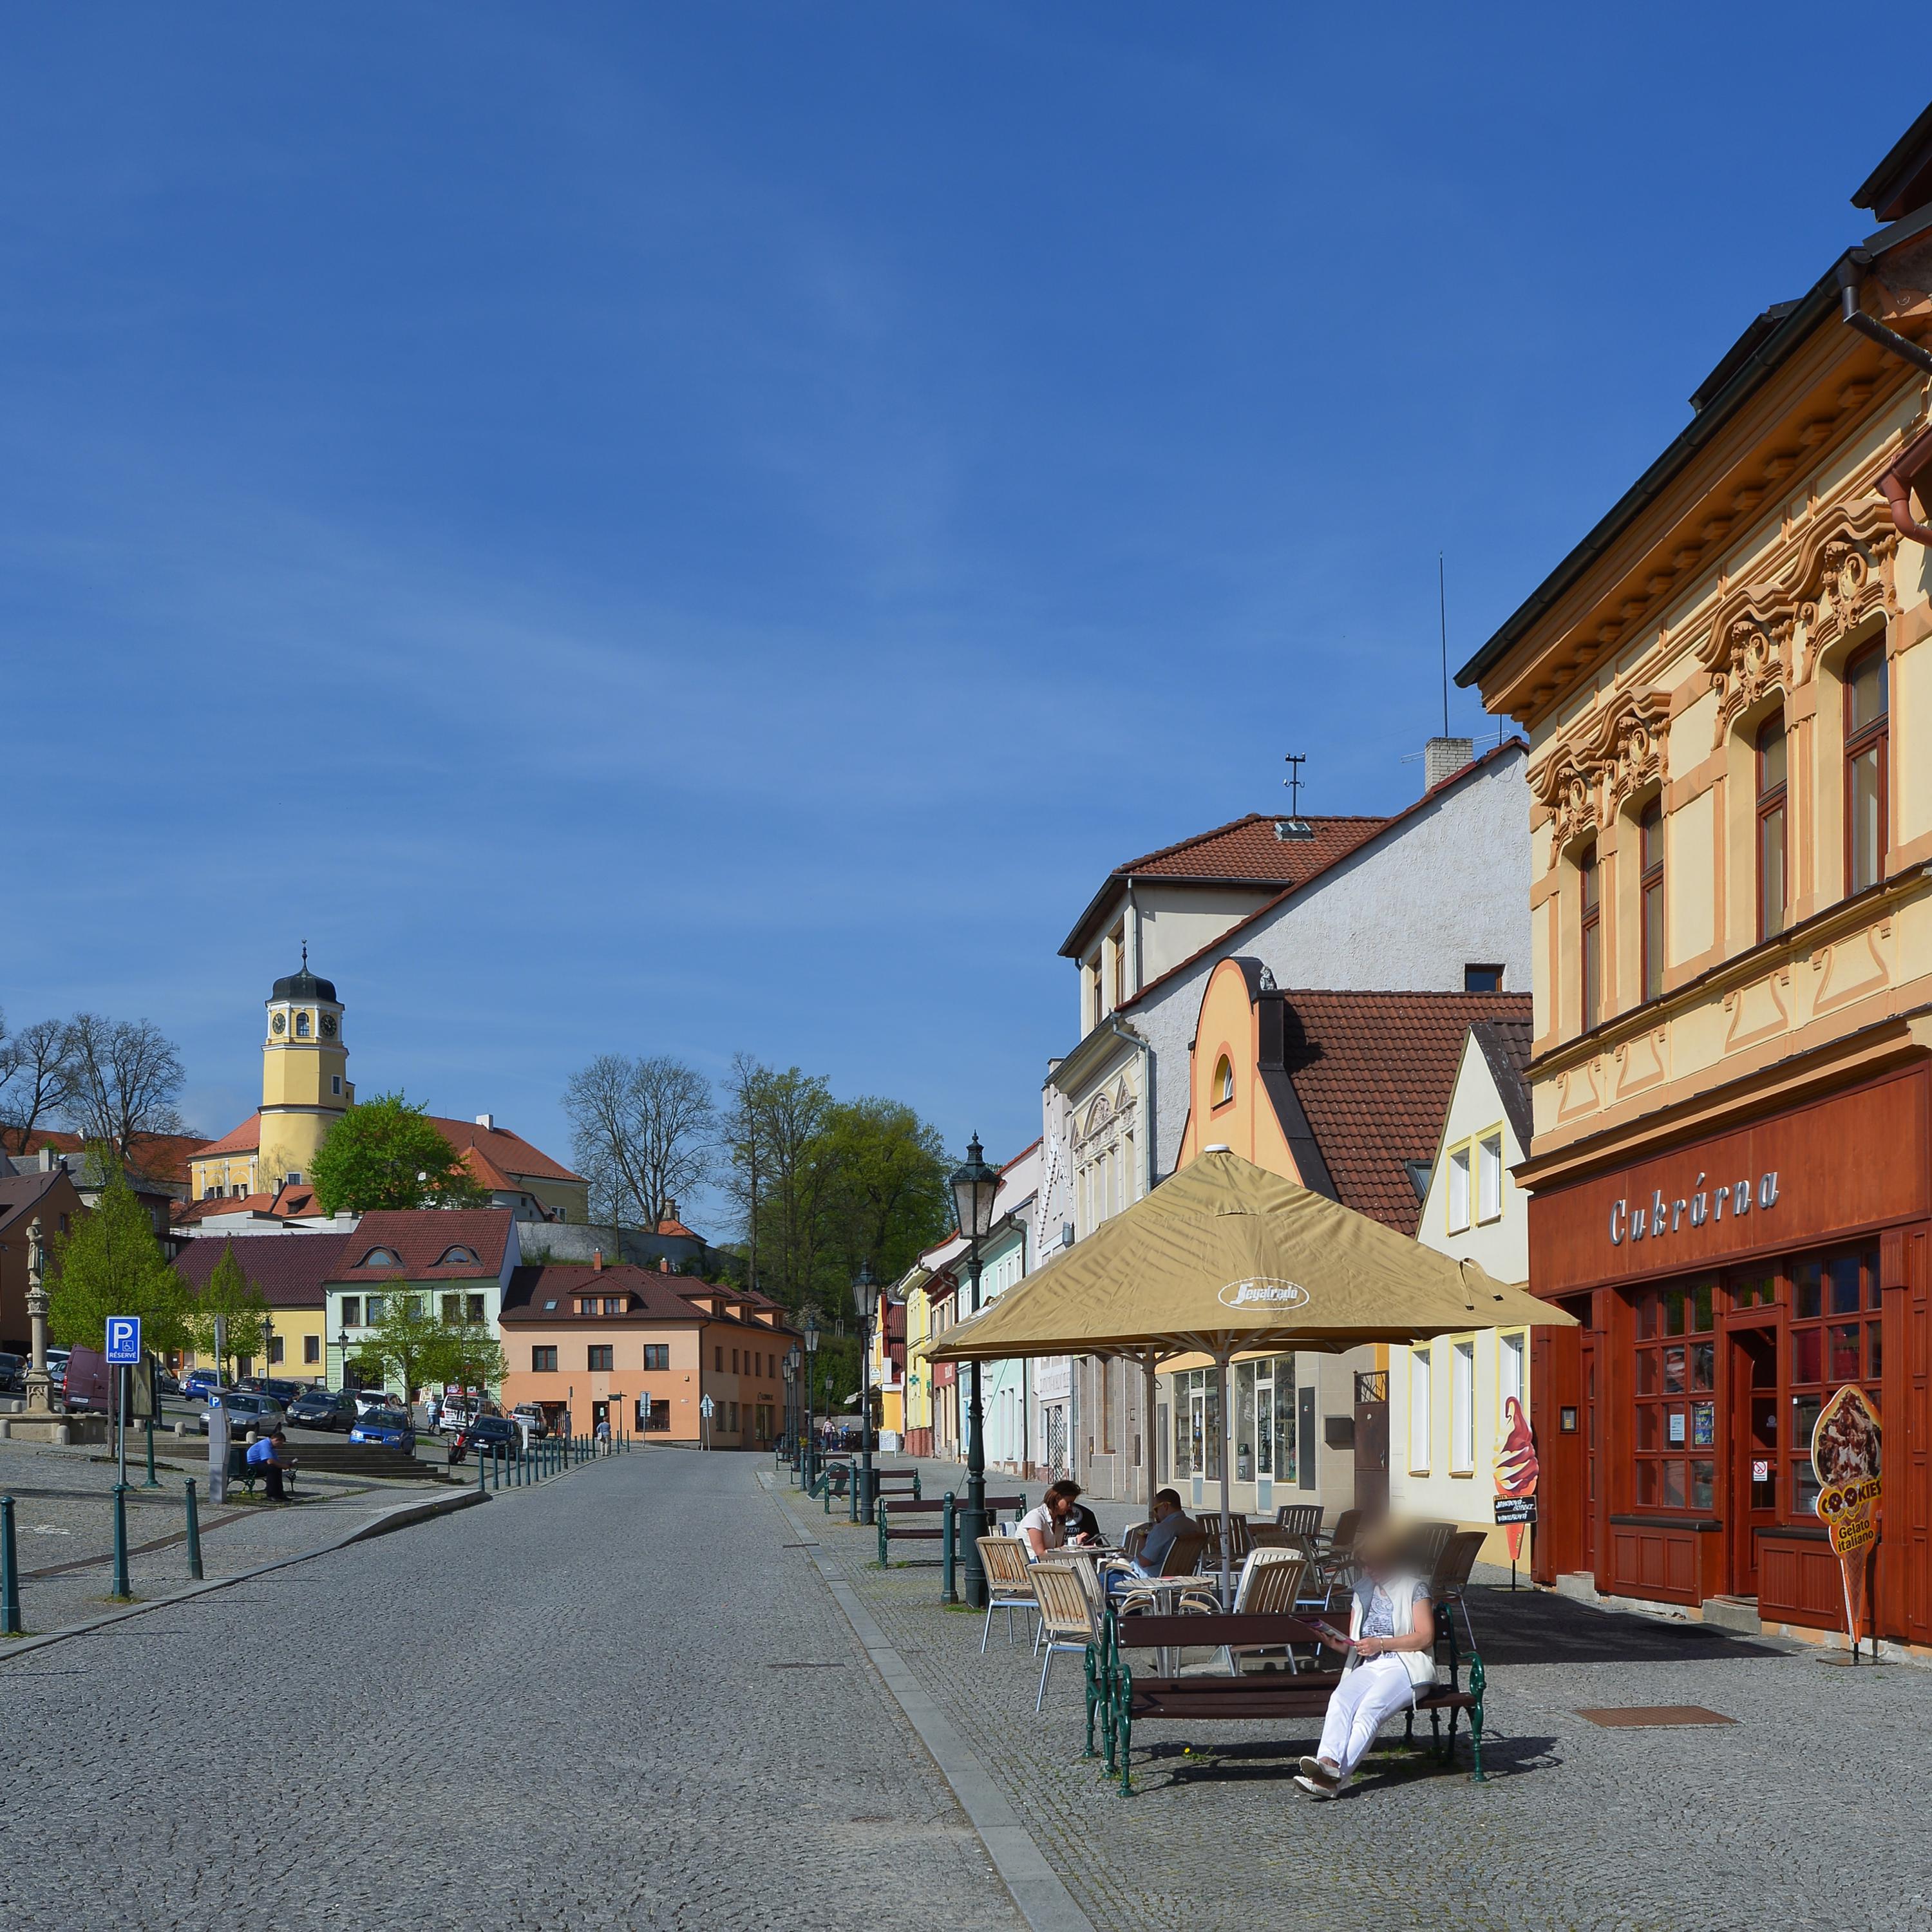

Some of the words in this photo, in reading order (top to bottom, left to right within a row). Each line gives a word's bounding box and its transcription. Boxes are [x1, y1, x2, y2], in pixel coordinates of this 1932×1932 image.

[1609, 1171, 1779, 1246] Cukrárna
[1229, 1282, 1298, 1305] Segafredo
[113, 1322, 133, 1349] P
[109, 1350, 137, 1359] RÉSERVÉ
[212, 1396, 220, 1407] P
[1821, 1481, 1882, 1515] COOKIES
[1838, 1520, 1870, 1539] Gelato
[1837, 1530, 1874, 1553] italiano
